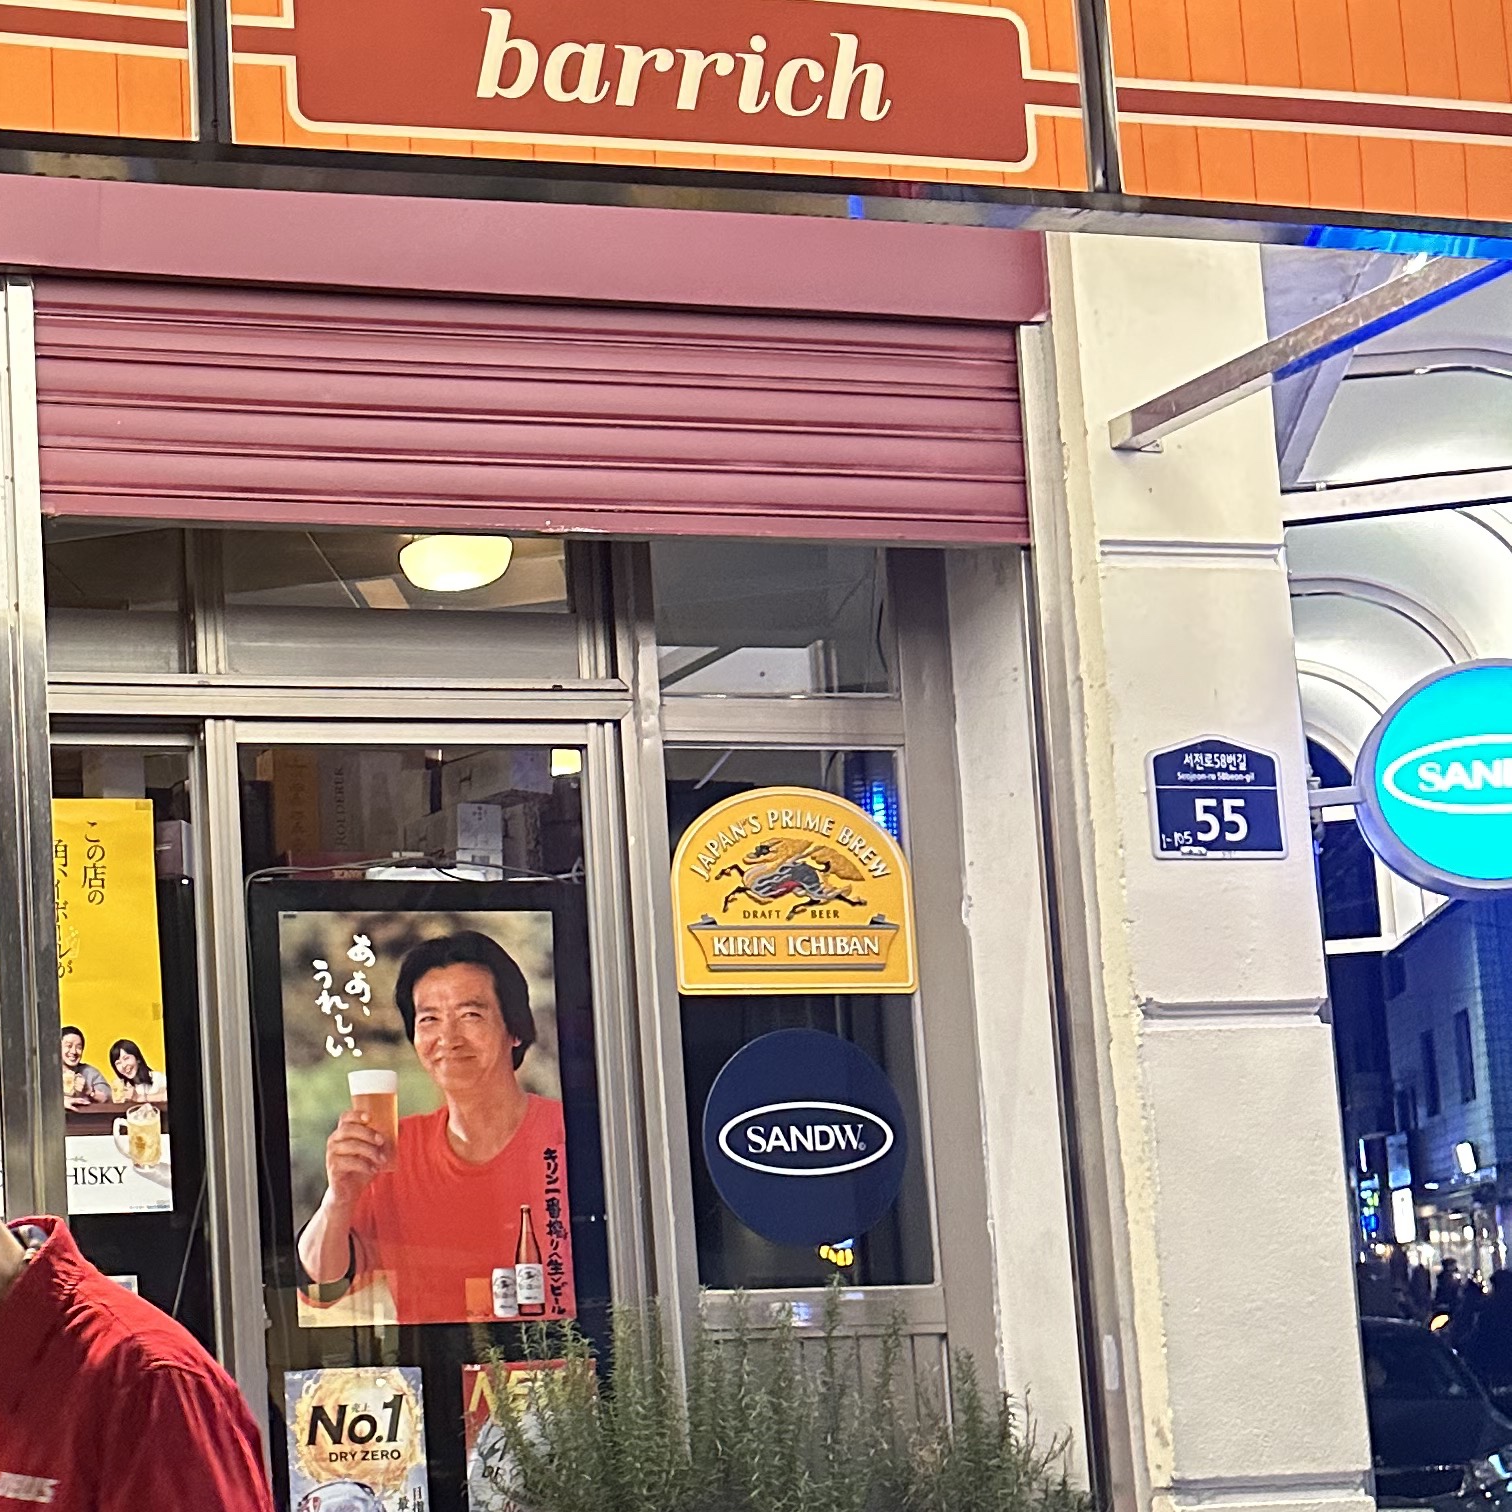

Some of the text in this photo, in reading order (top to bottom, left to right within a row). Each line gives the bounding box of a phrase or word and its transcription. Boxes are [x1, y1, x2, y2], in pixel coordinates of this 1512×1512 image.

[476, 7, 892, 122] barrich
[1183, 753, 1247, 771] 서전로58번길
[1194, 798, 1249, 842] 55
[690, 809, 892, 882] JAPAN'S PRIME BREW
[81, 820, 107, 906] この店の
[742, 909, 841, 920] DRAFT BEER
[713, 935, 881, 957] KIRIN ICHIBAN
[66, 1165, 128, 1186] HISKY
[305, 1393, 407, 1447] No.1
[329, 1449, 401, 1463] DRY ZERO
